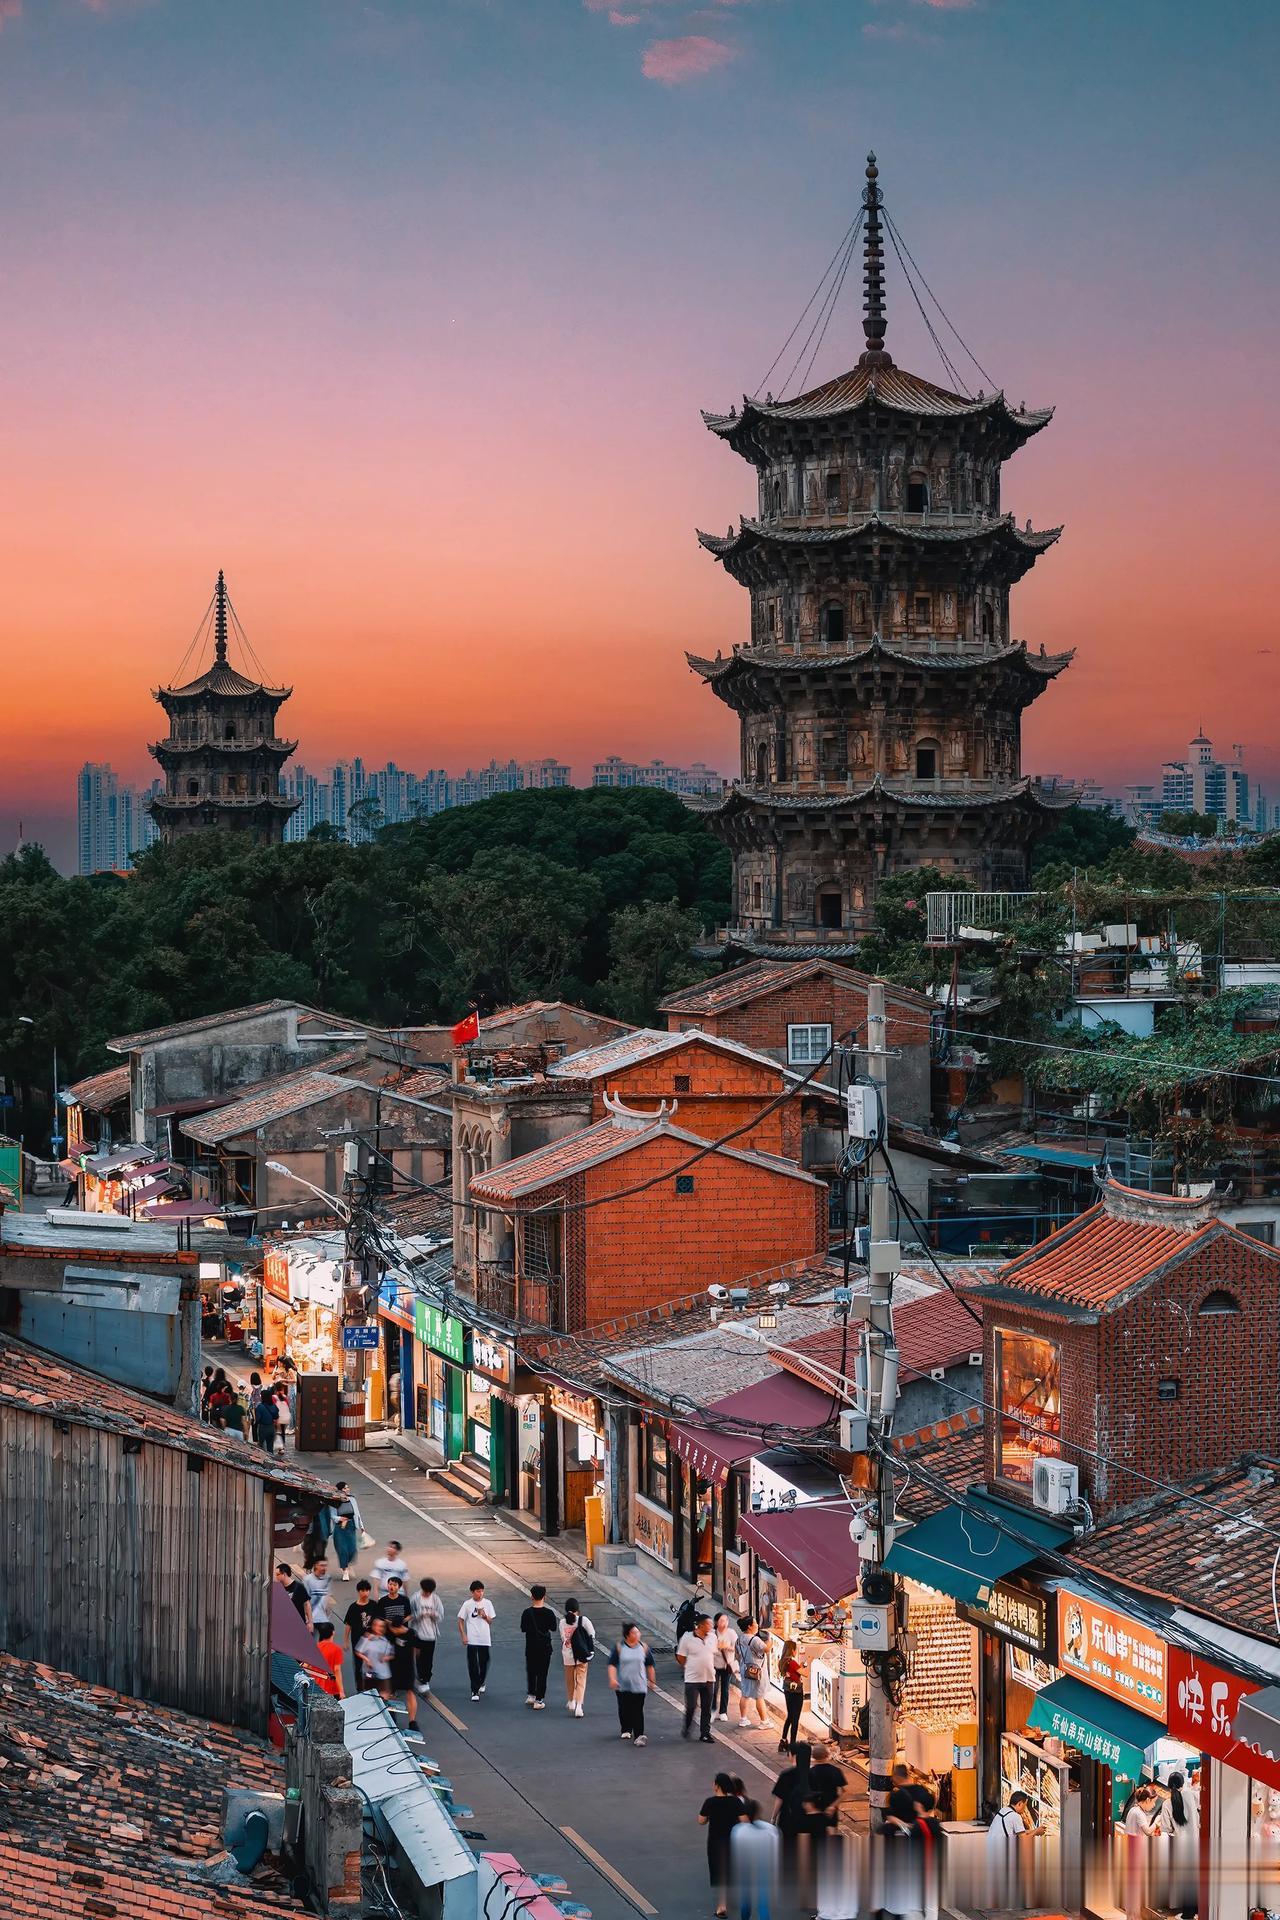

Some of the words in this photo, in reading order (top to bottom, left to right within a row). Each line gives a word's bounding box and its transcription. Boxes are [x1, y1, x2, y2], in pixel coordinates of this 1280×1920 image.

[1091, 1616, 1128, 1661] 乐仙串
[1178, 1671, 1246, 1737] 快乐
[1052, 1713, 1121, 1765] 乐仙串乐山钵钵鸡
